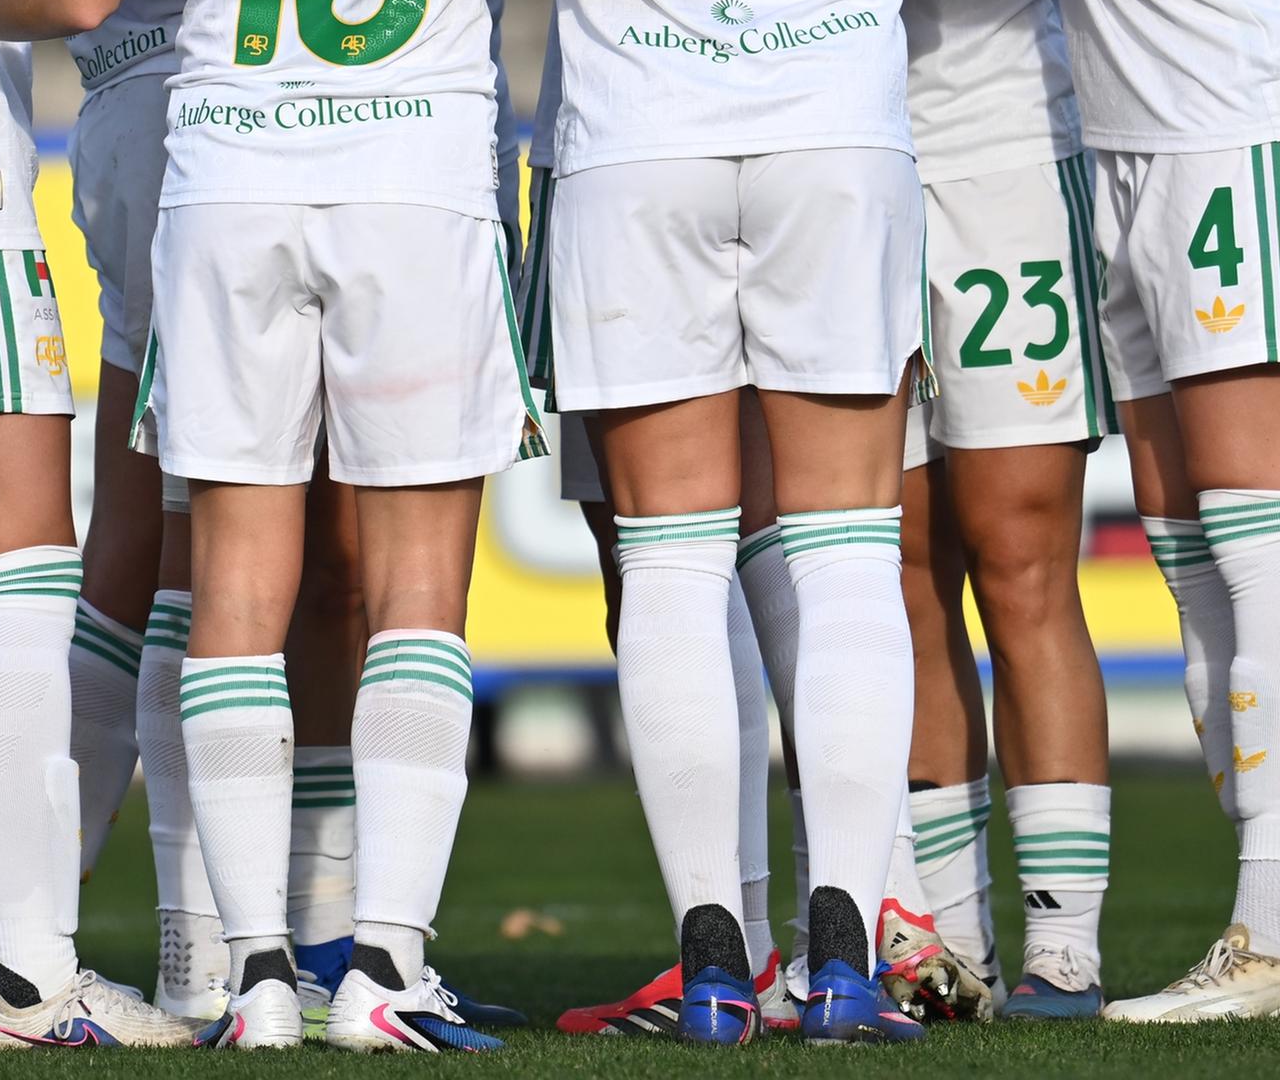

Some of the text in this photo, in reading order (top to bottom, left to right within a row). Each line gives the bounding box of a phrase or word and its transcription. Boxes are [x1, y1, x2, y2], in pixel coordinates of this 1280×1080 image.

[75, 25, 168, 81] Collection
[619, 10, 880, 64] Auberge Collection
[175, 95, 433, 135] Auberge Collection
[1186, 186, 1244, 288] 4
[953, 259, 1070, 369] 23
